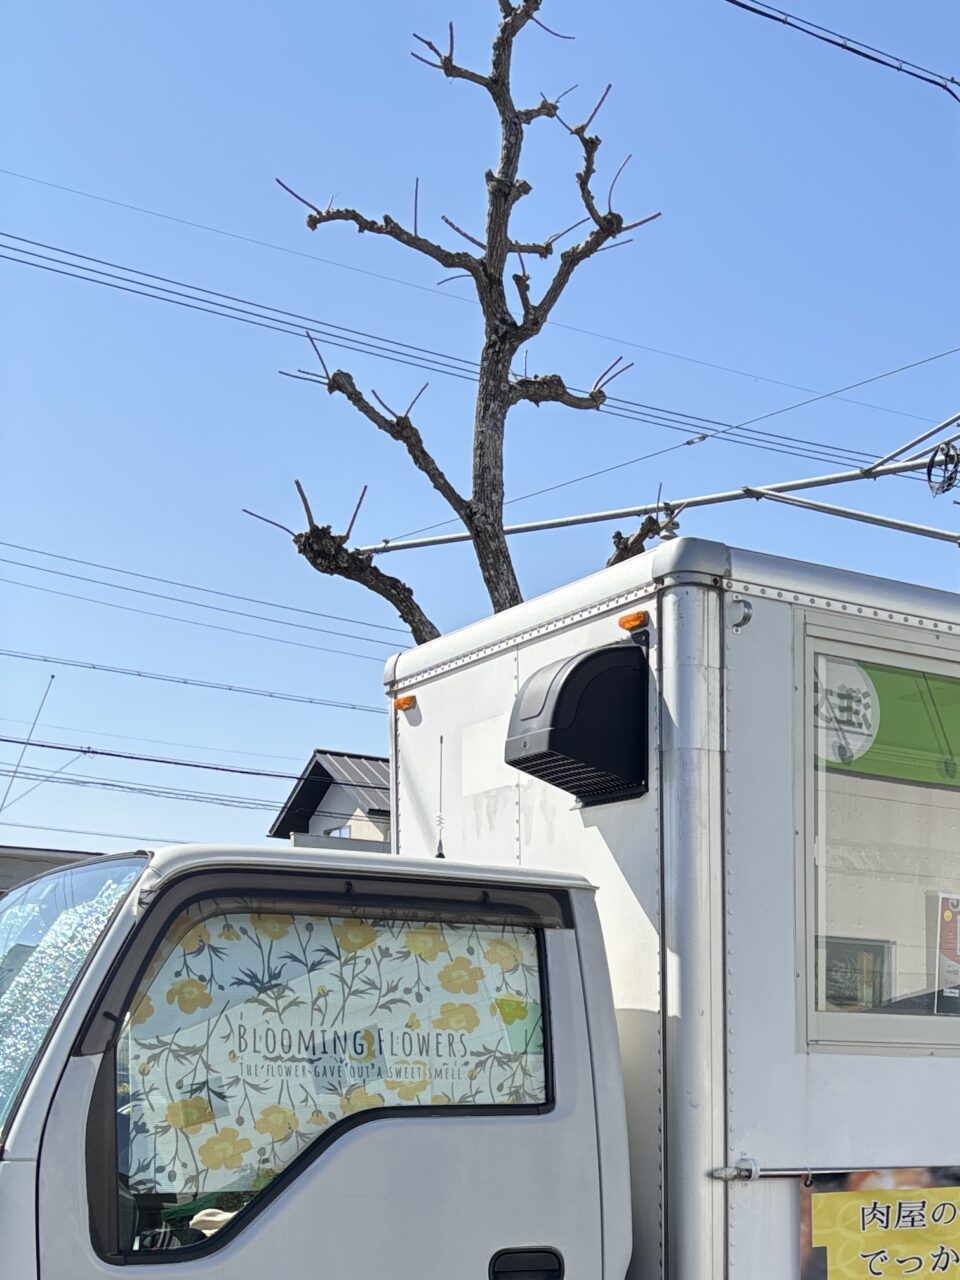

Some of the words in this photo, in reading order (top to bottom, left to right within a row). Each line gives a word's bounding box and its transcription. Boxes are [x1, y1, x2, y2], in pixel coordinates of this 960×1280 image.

[238, 1024, 365, 1056] BLOOMING
[377, 1028, 467, 1058] FLOWERS
[239, 1062, 260, 1078] THE
[266, 1063, 307, 1078] FLOWER
[314, 1063, 343, 1078] GAVE
[389, 1064, 422, 1079] SWEET
